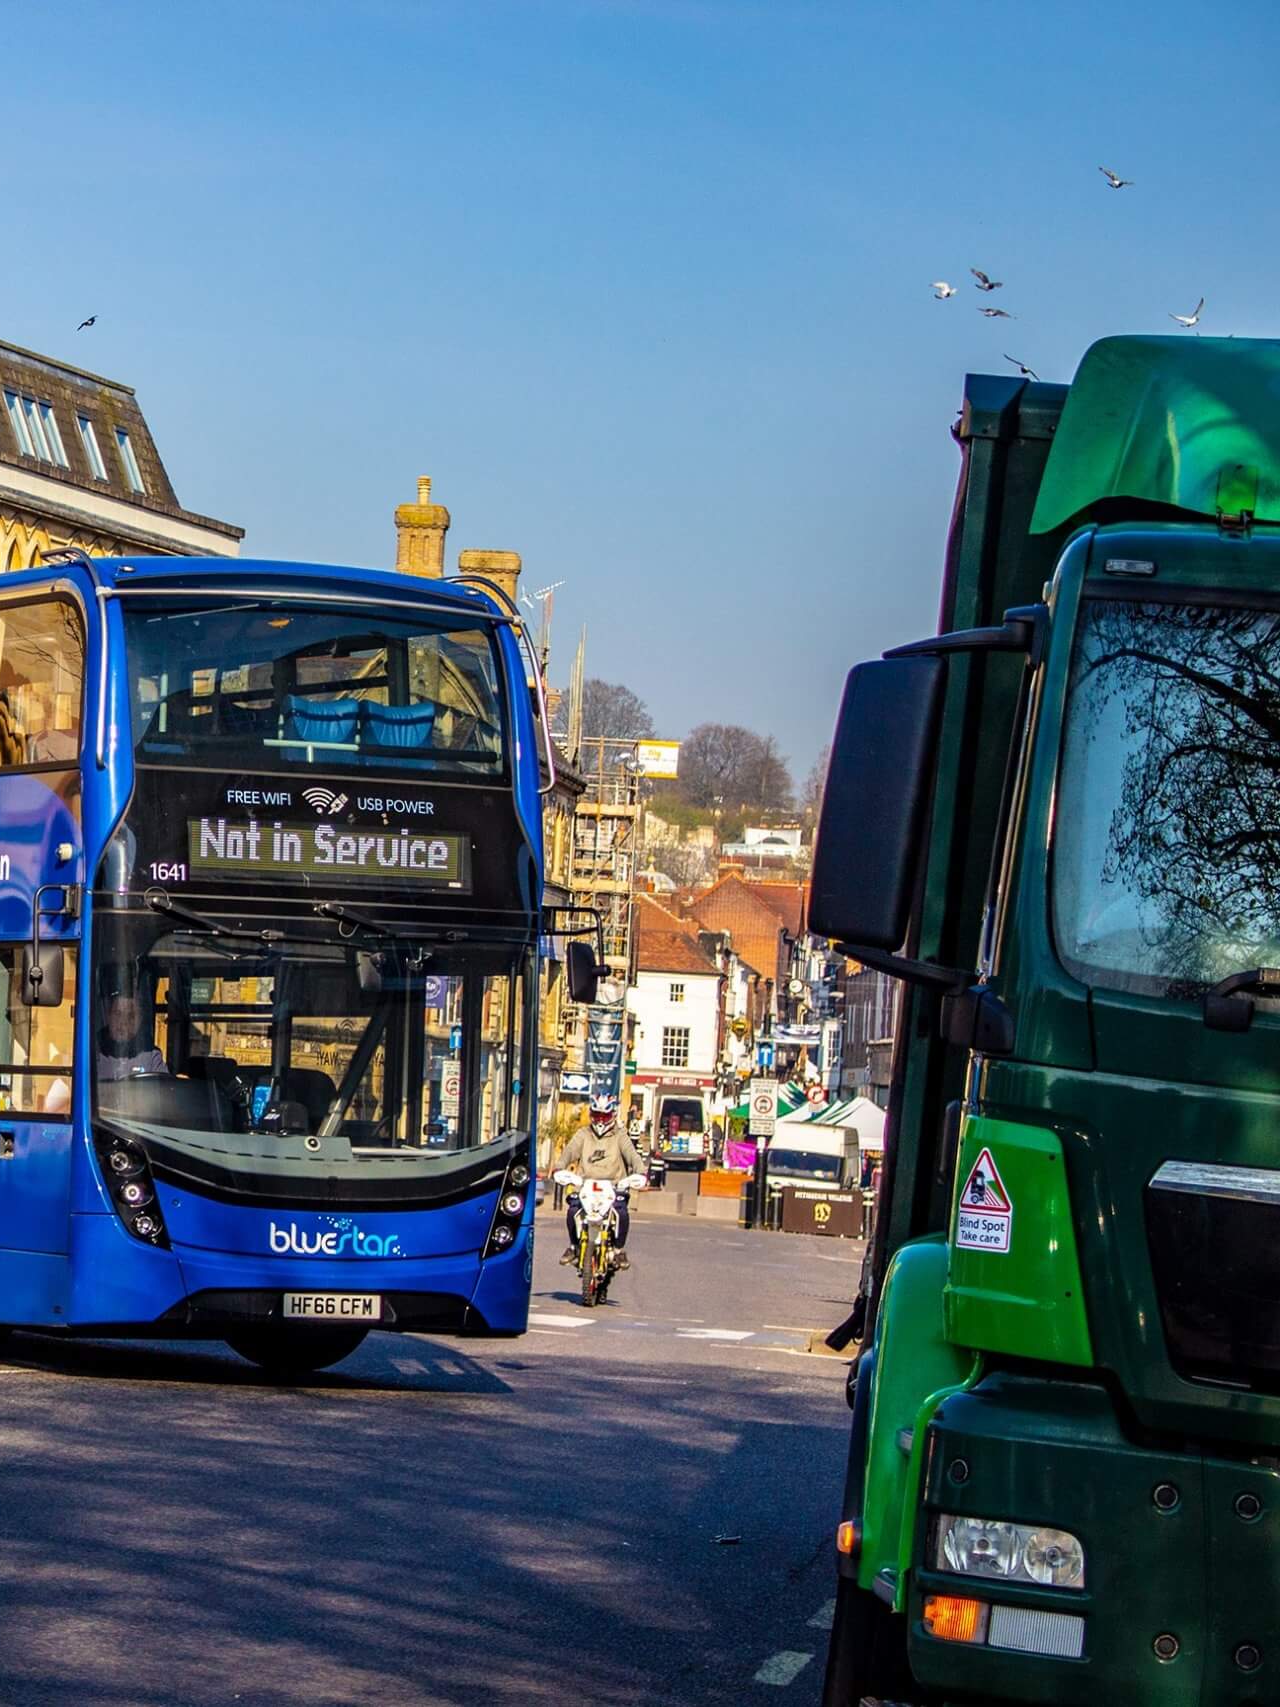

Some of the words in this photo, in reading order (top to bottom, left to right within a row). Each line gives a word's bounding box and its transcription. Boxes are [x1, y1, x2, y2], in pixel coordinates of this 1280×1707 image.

[227, 790, 261, 805] FREE
[262, 792, 291, 806] WIFI
[357, 797, 383, 811] USB
[386, 800, 435, 815] POWER
[200, 818, 261, 860] Not
[273, 822, 301, 862] in
[314, 824, 449, 869] Service
[150, 863, 187, 882] 1641
[592, 1182, 604, 1192] L
[960, 1217, 979, 1229] Blind
[981, 1220, 1005, 1232] Spot
[269, 1221, 398, 1257] bluestar
[961, 1230, 978, 1241] Take
[979, 1233, 1001, 1244] care
[290, 1297, 335, 1315] HF66
[340, 1298, 373, 1315] CFM
